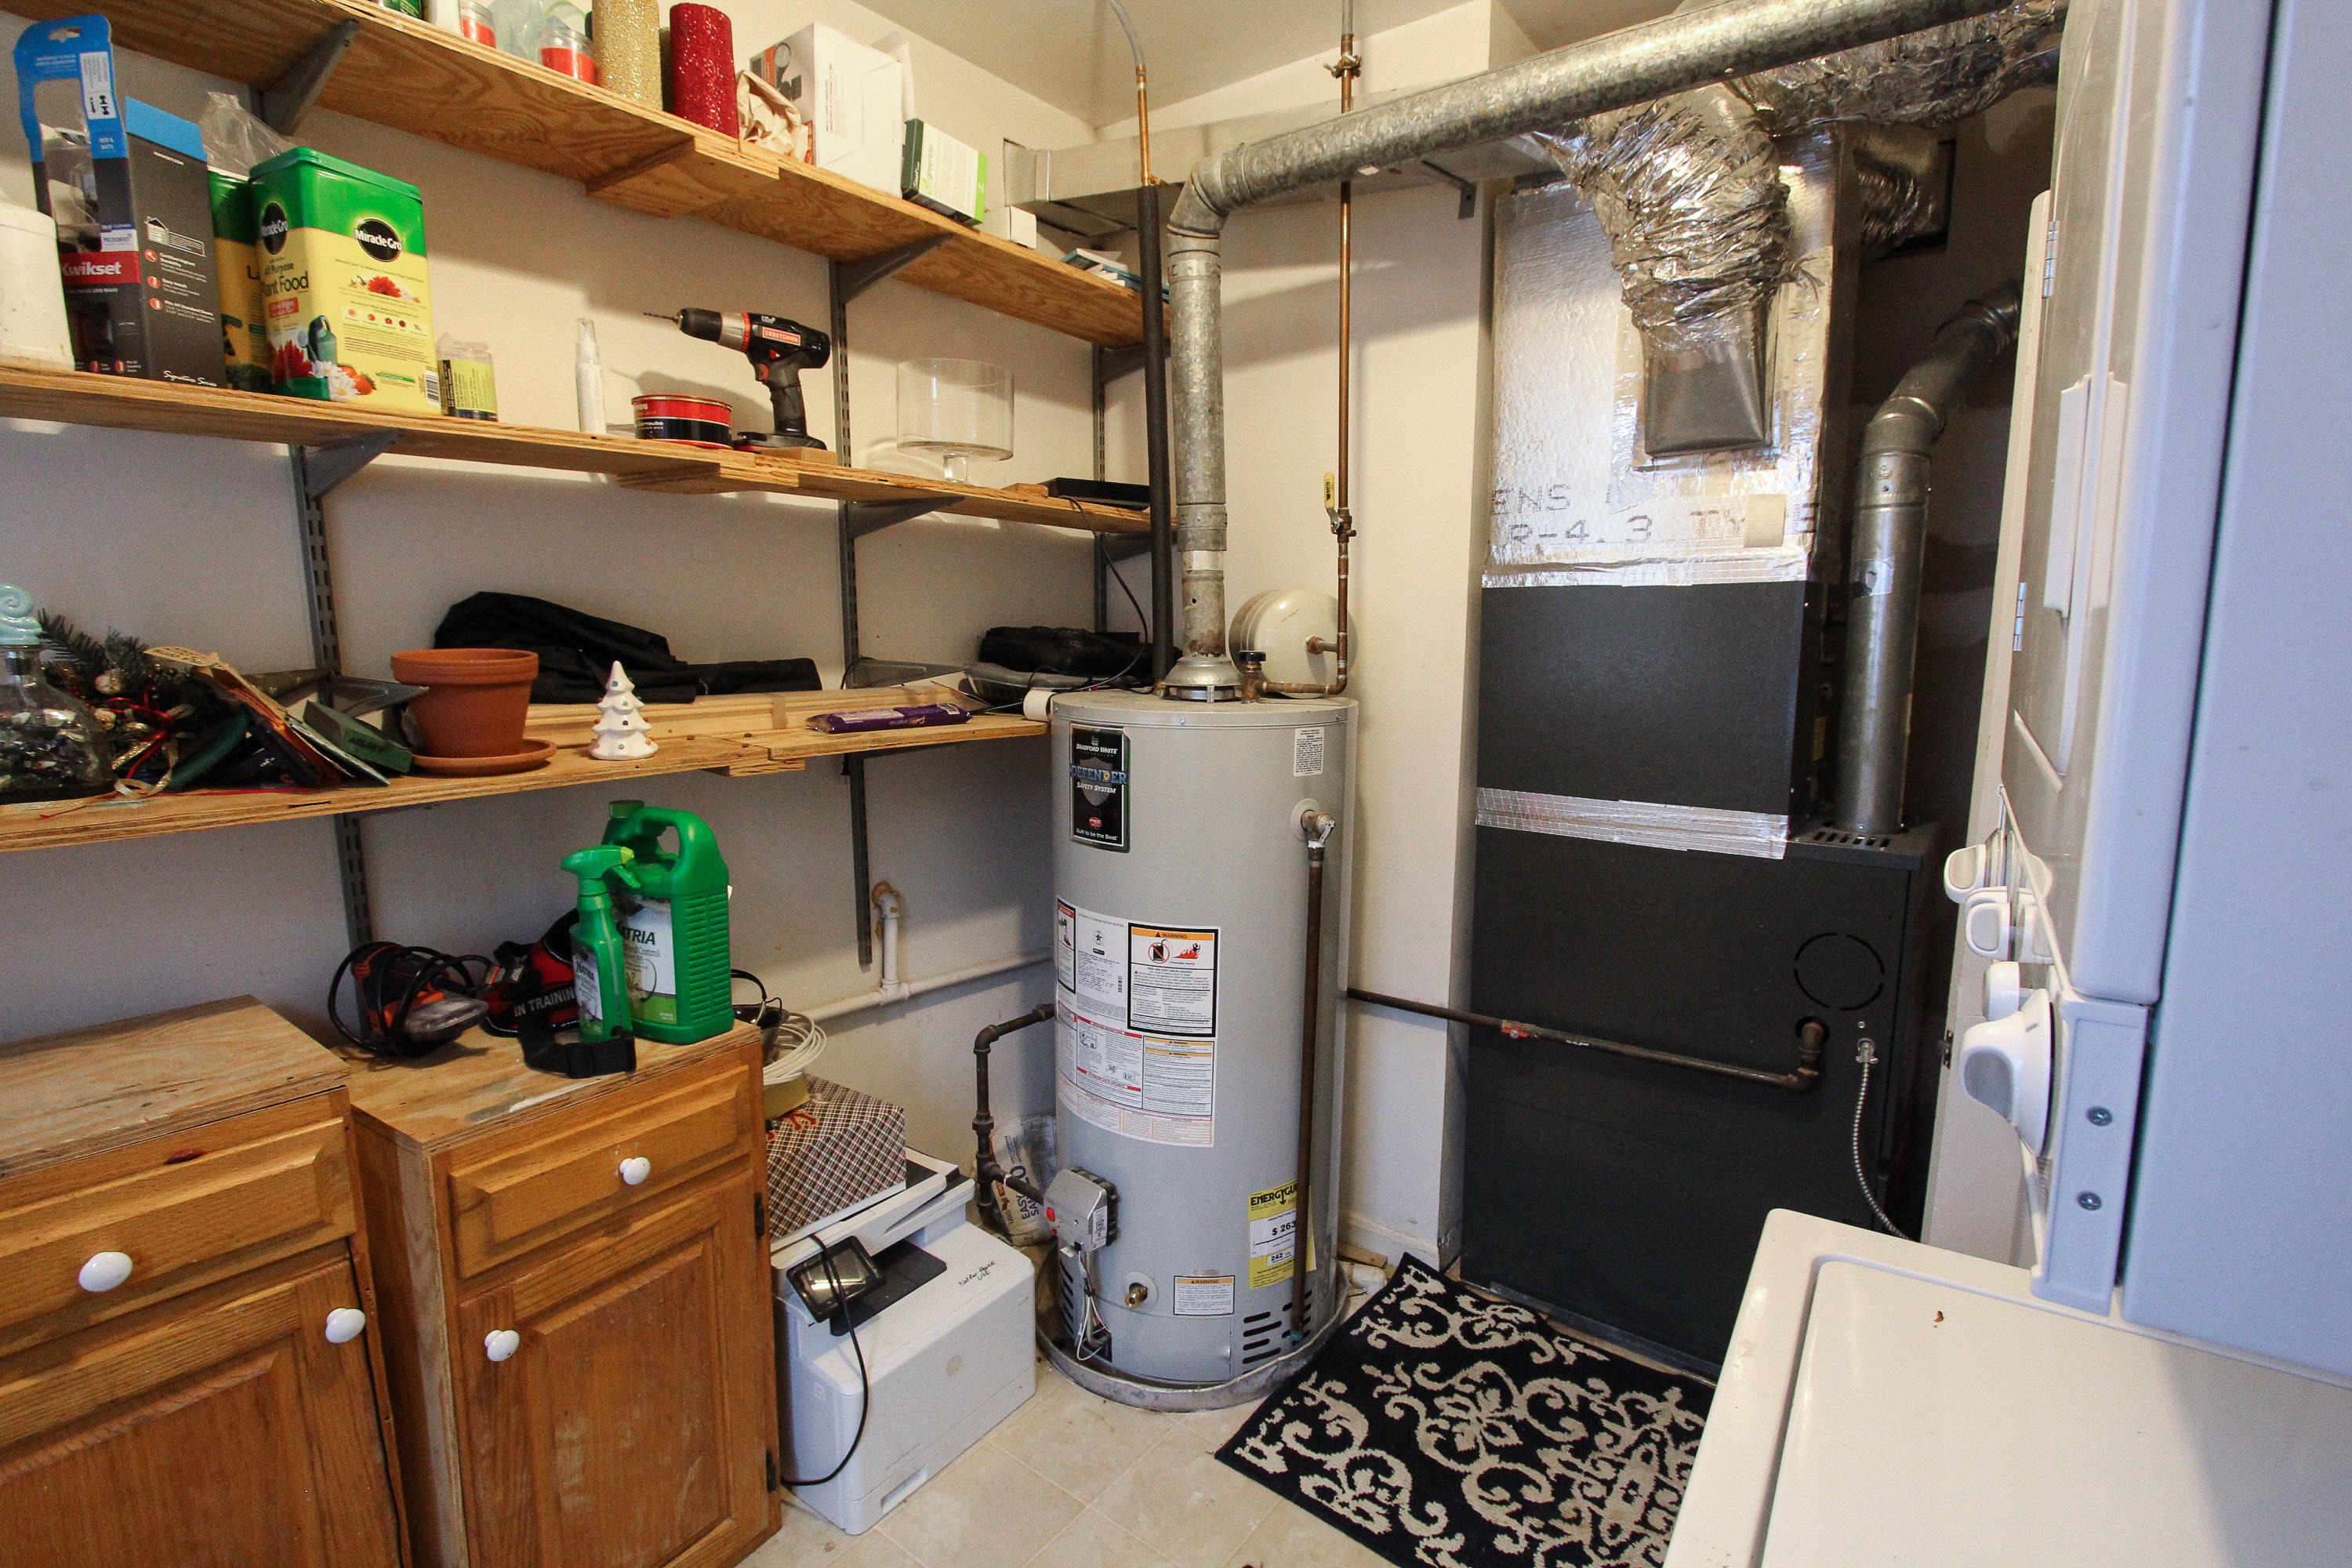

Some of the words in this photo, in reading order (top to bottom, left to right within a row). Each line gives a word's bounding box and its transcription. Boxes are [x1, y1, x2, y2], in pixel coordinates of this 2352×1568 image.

[354, 229, 403, 251] Miracle-Gro
[279, 270, 310, 292] Food
[1076, 743, 1100, 753] BRADFORD
[1100, 746, 1119, 755] WHITE
[1070, 764, 1127, 785] DEFENDER
[1076, 782, 1094, 791] SAFETY
[1094, 785, 1116, 794] SYSTEM
[514, 1004, 527, 1017] IN
[528, 987, 575, 1011] TRAININ
[1250, 1182, 1298, 1207] ENERGYGU
[1016, 1194, 1031, 1220] EASY
[1272, 1227, 1278, 1236] $
[1280, 1220, 1297, 1233] 263
[1271, 1252, 1283, 1261] 242
